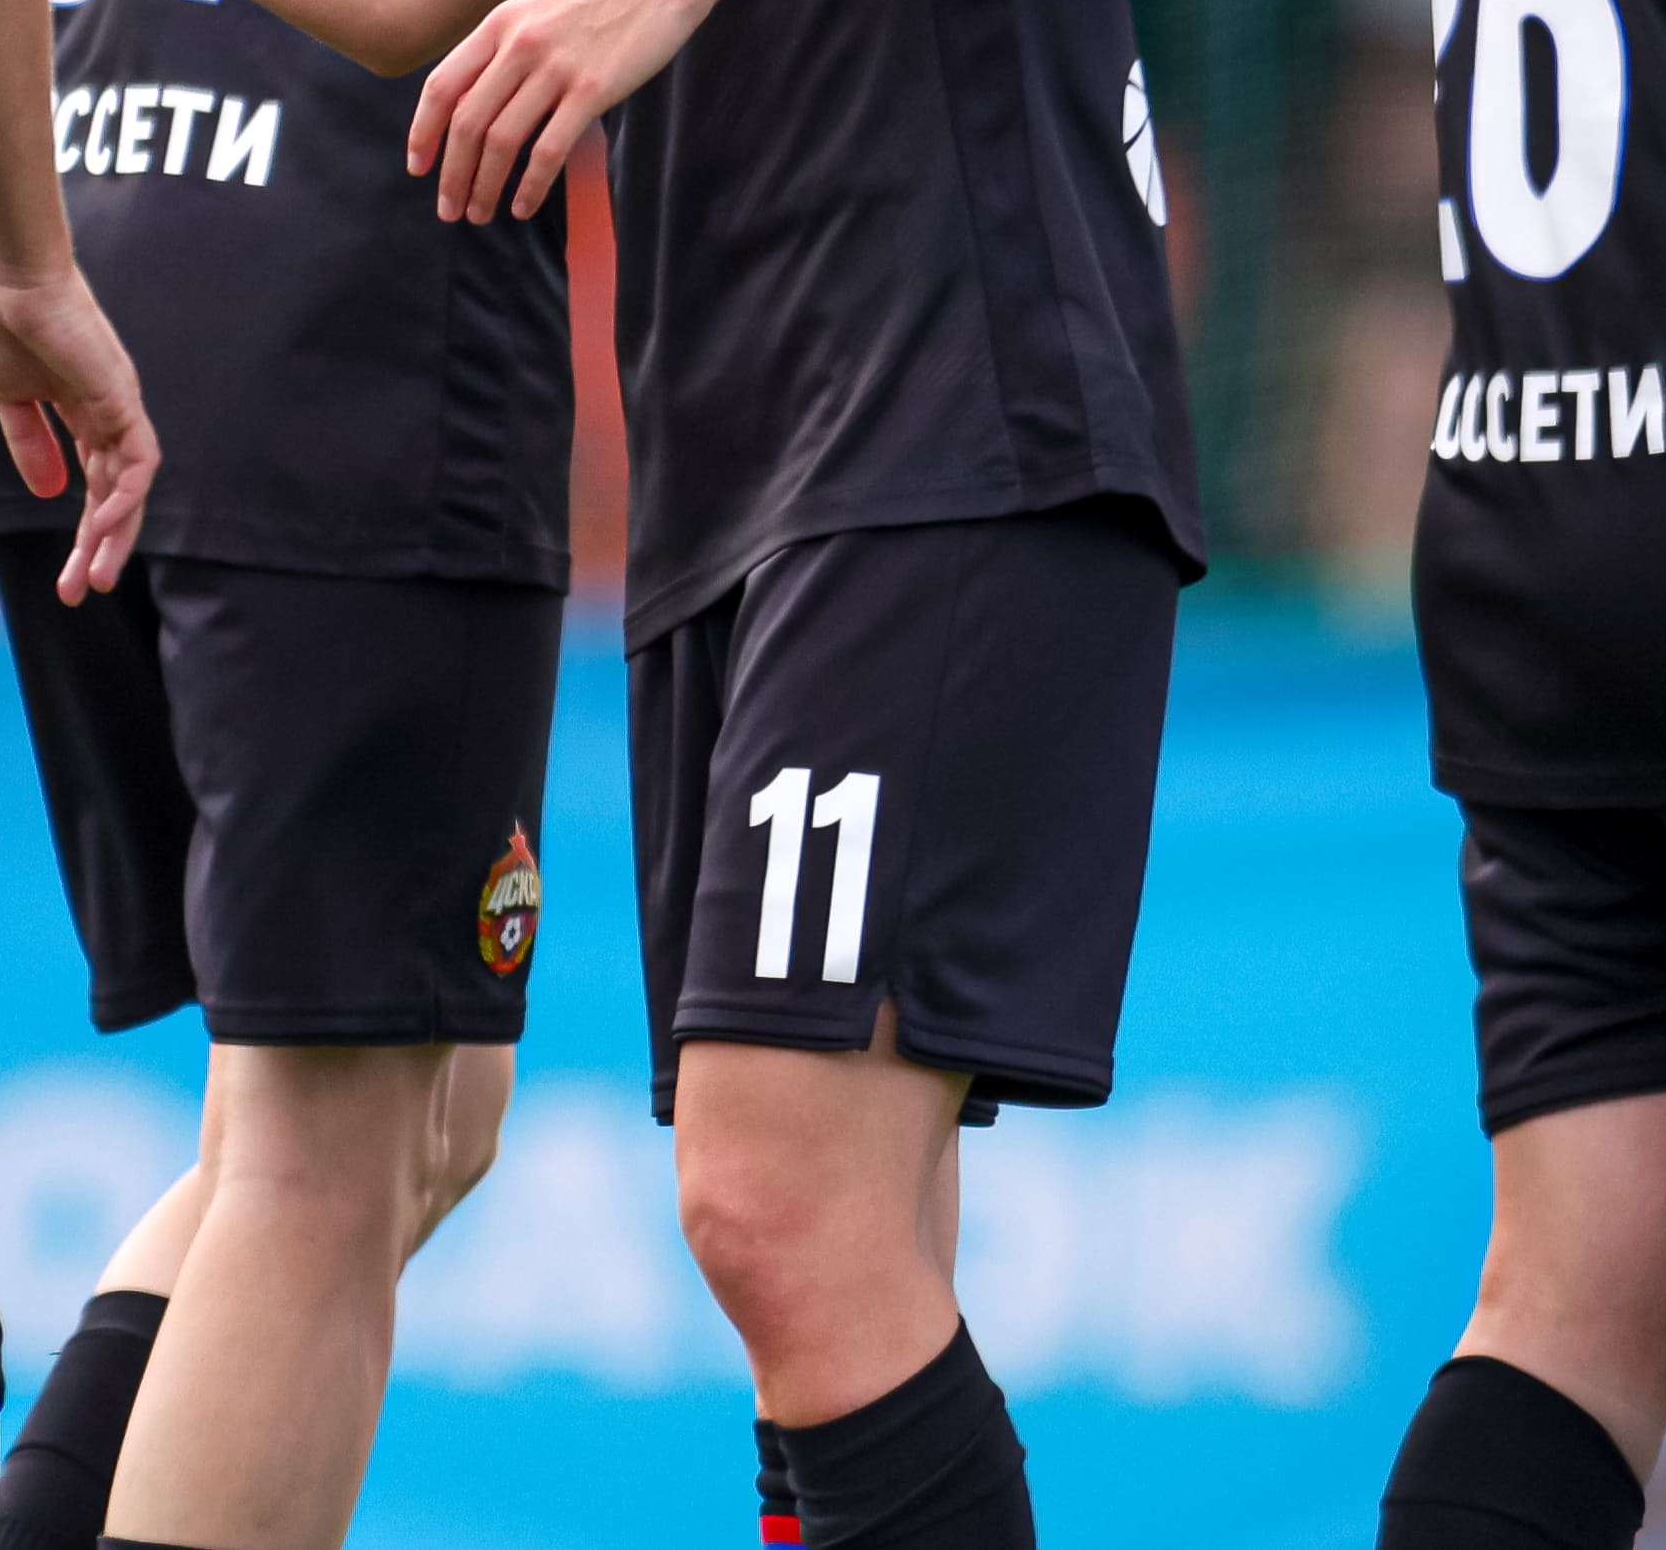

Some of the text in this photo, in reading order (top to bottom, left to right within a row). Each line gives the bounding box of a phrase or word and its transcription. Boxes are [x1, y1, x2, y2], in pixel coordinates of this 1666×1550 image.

[50, 83, 281, 187] ССЕТИ
[1430, 366, 1666, 463] ОССЕТИ
[749, 767, 881, 984] 11
